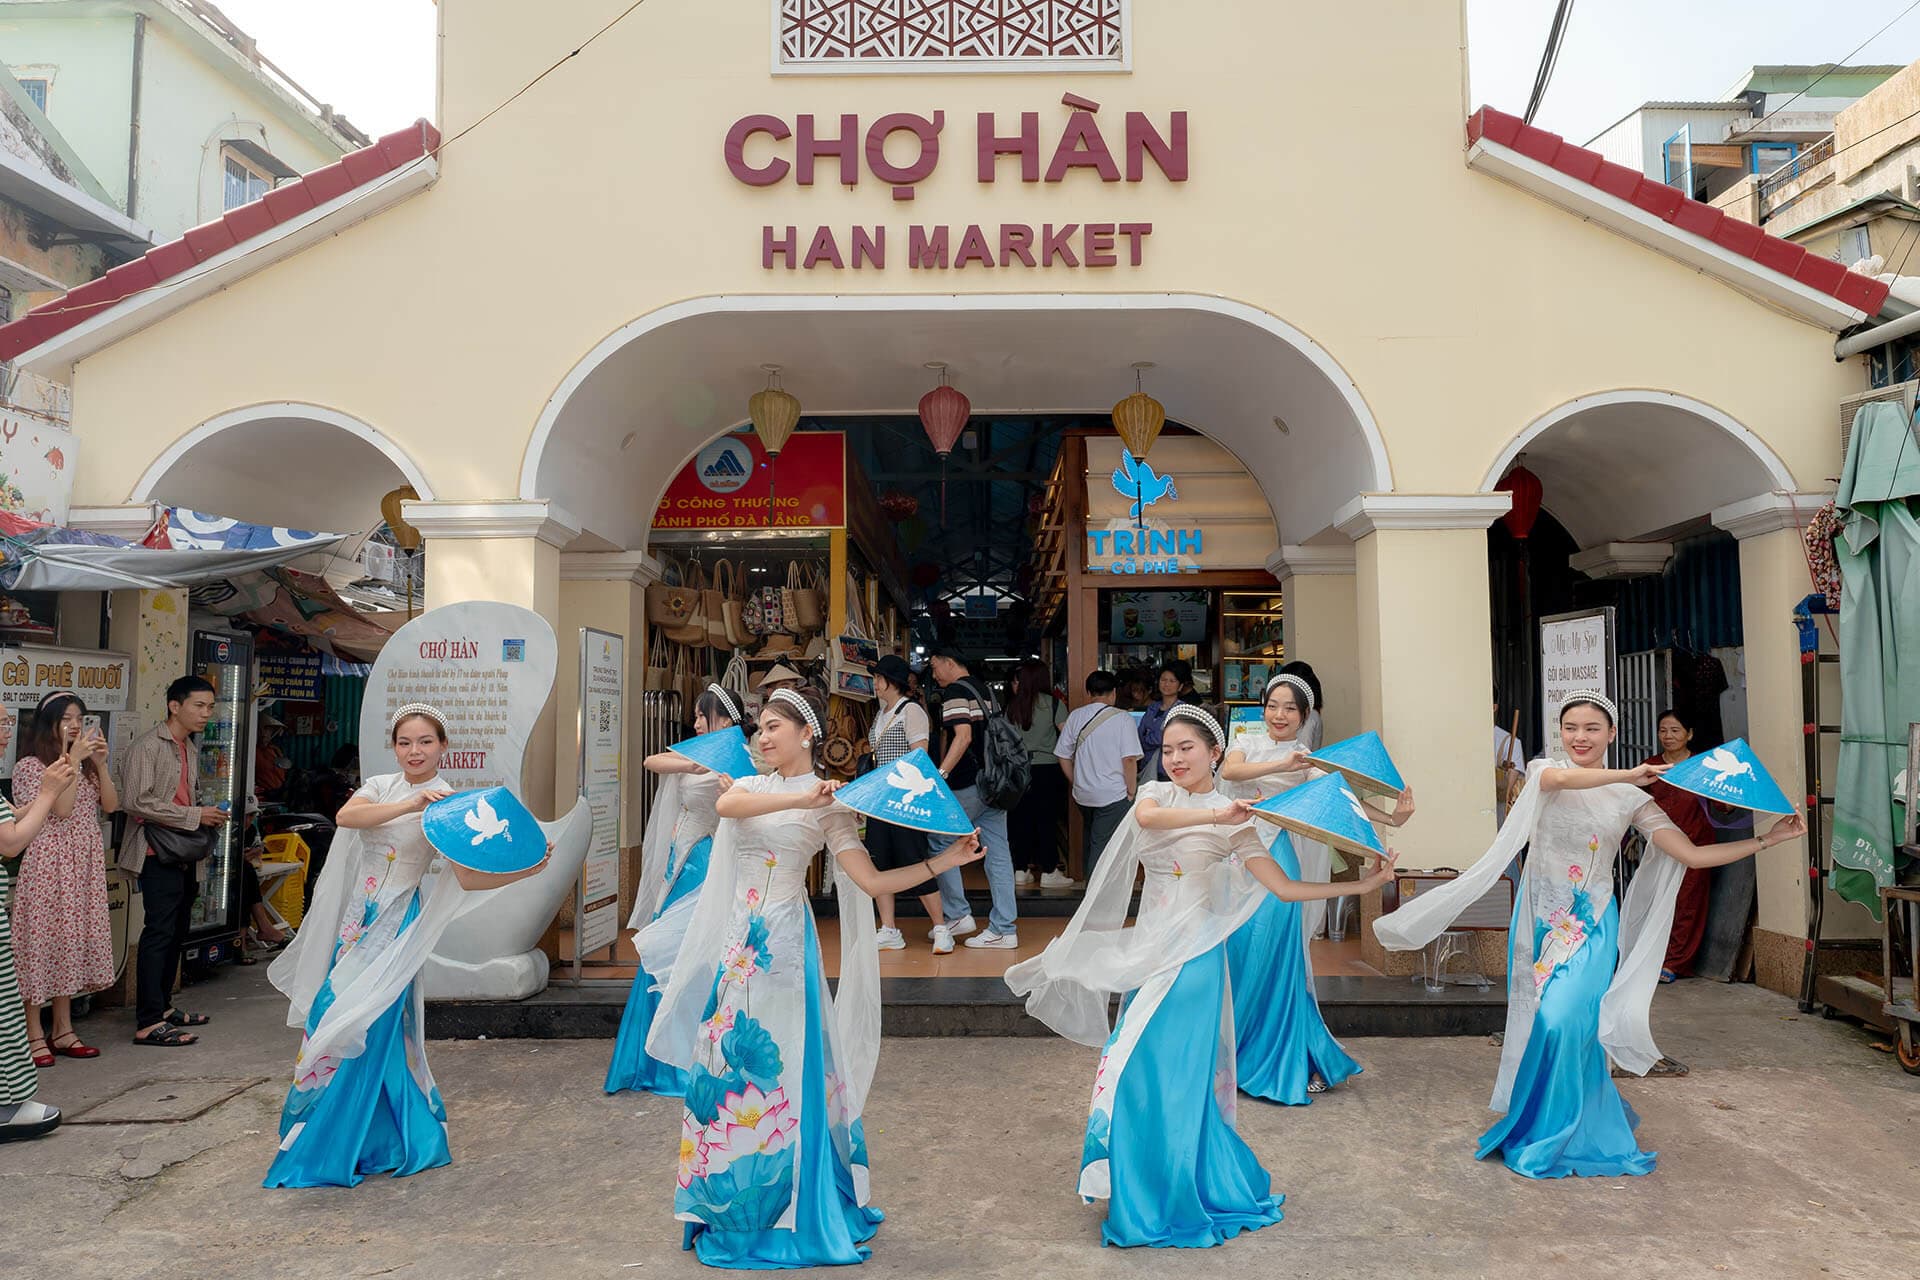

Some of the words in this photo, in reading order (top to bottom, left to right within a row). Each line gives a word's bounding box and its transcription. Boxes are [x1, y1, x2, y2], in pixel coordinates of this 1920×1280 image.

[724, 110, 945, 201] CHỢ
[977, 92, 1188, 183] HÀN
[762, 225, 886, 270] HAN
[908, 223, 1152, 269] MARKET
[657, 496, 671, 509] Ở
[676, 496, 726, 509] CÔNG
[651, 514, 691, 527] ÀNH
[696, 511, 730, 526] PHỐ
[734, 514, 757, 526] ĐÀ
[1143, 557, 1179, 575] PHÊ
[419, 638, 447, 662] CHỢ
[450, 636, 479, 659] HÀN
[3, 655, 29, 686] CÀ
[36, 661, 73, 687] PHÊ
[78, 662, 124, 689] MUỐI
[1571, 664, 1598, 681] MASSAGE
[3, 692, 18, 702] SALT
[19, 692, 40, 702] COFFEE
[1547, 687, 1566, 703] PHÒN
